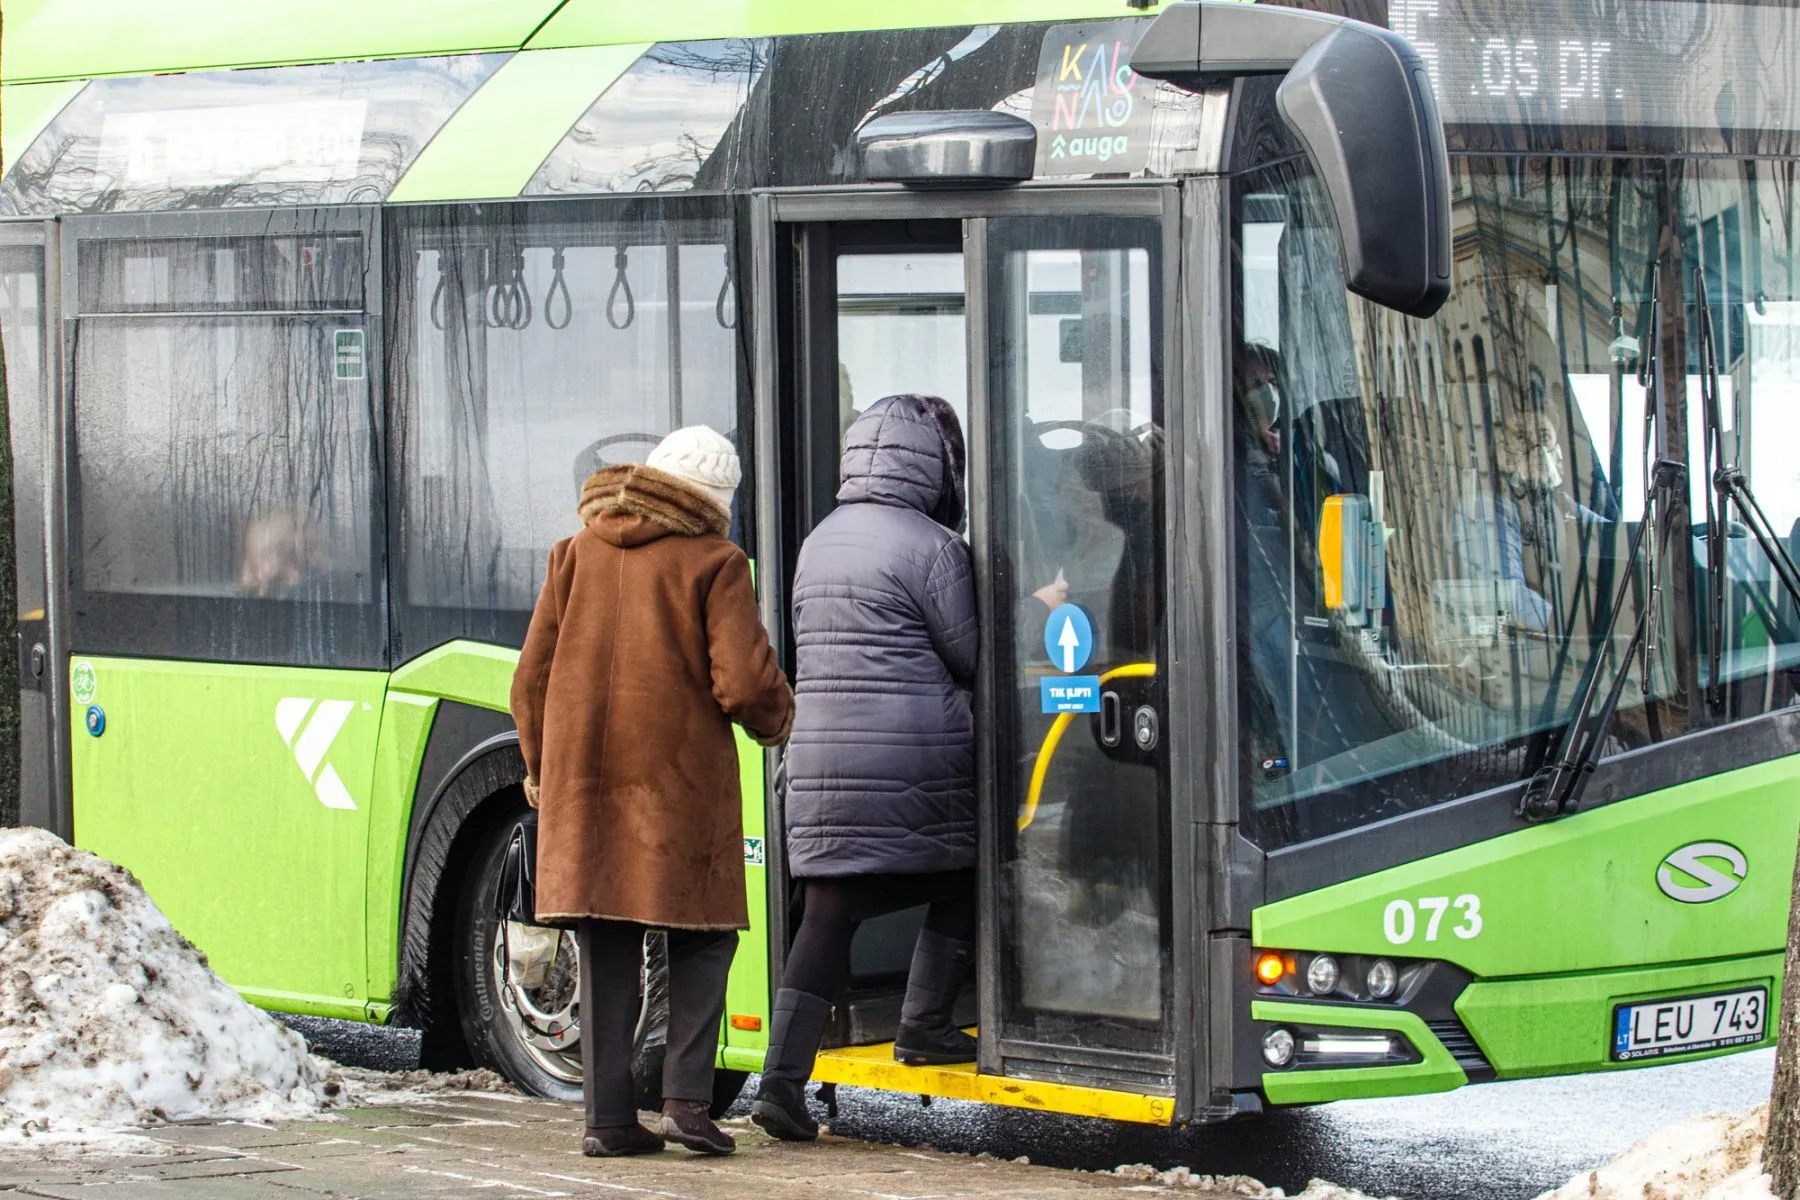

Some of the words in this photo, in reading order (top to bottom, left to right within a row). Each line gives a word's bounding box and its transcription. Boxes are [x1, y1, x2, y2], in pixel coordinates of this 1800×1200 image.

[1559, 40, 1624, 109] pr.
[1069, 135, 1129, 162] auga
[1383, 893, 1483, 945] 073
[473, 930, 495, 1022] Continental
[1616, 1034, 1629, 1046] LT
[1633, 1004, 1694, 1045] LEU
[1712, 996, 1760, 1035] 743
